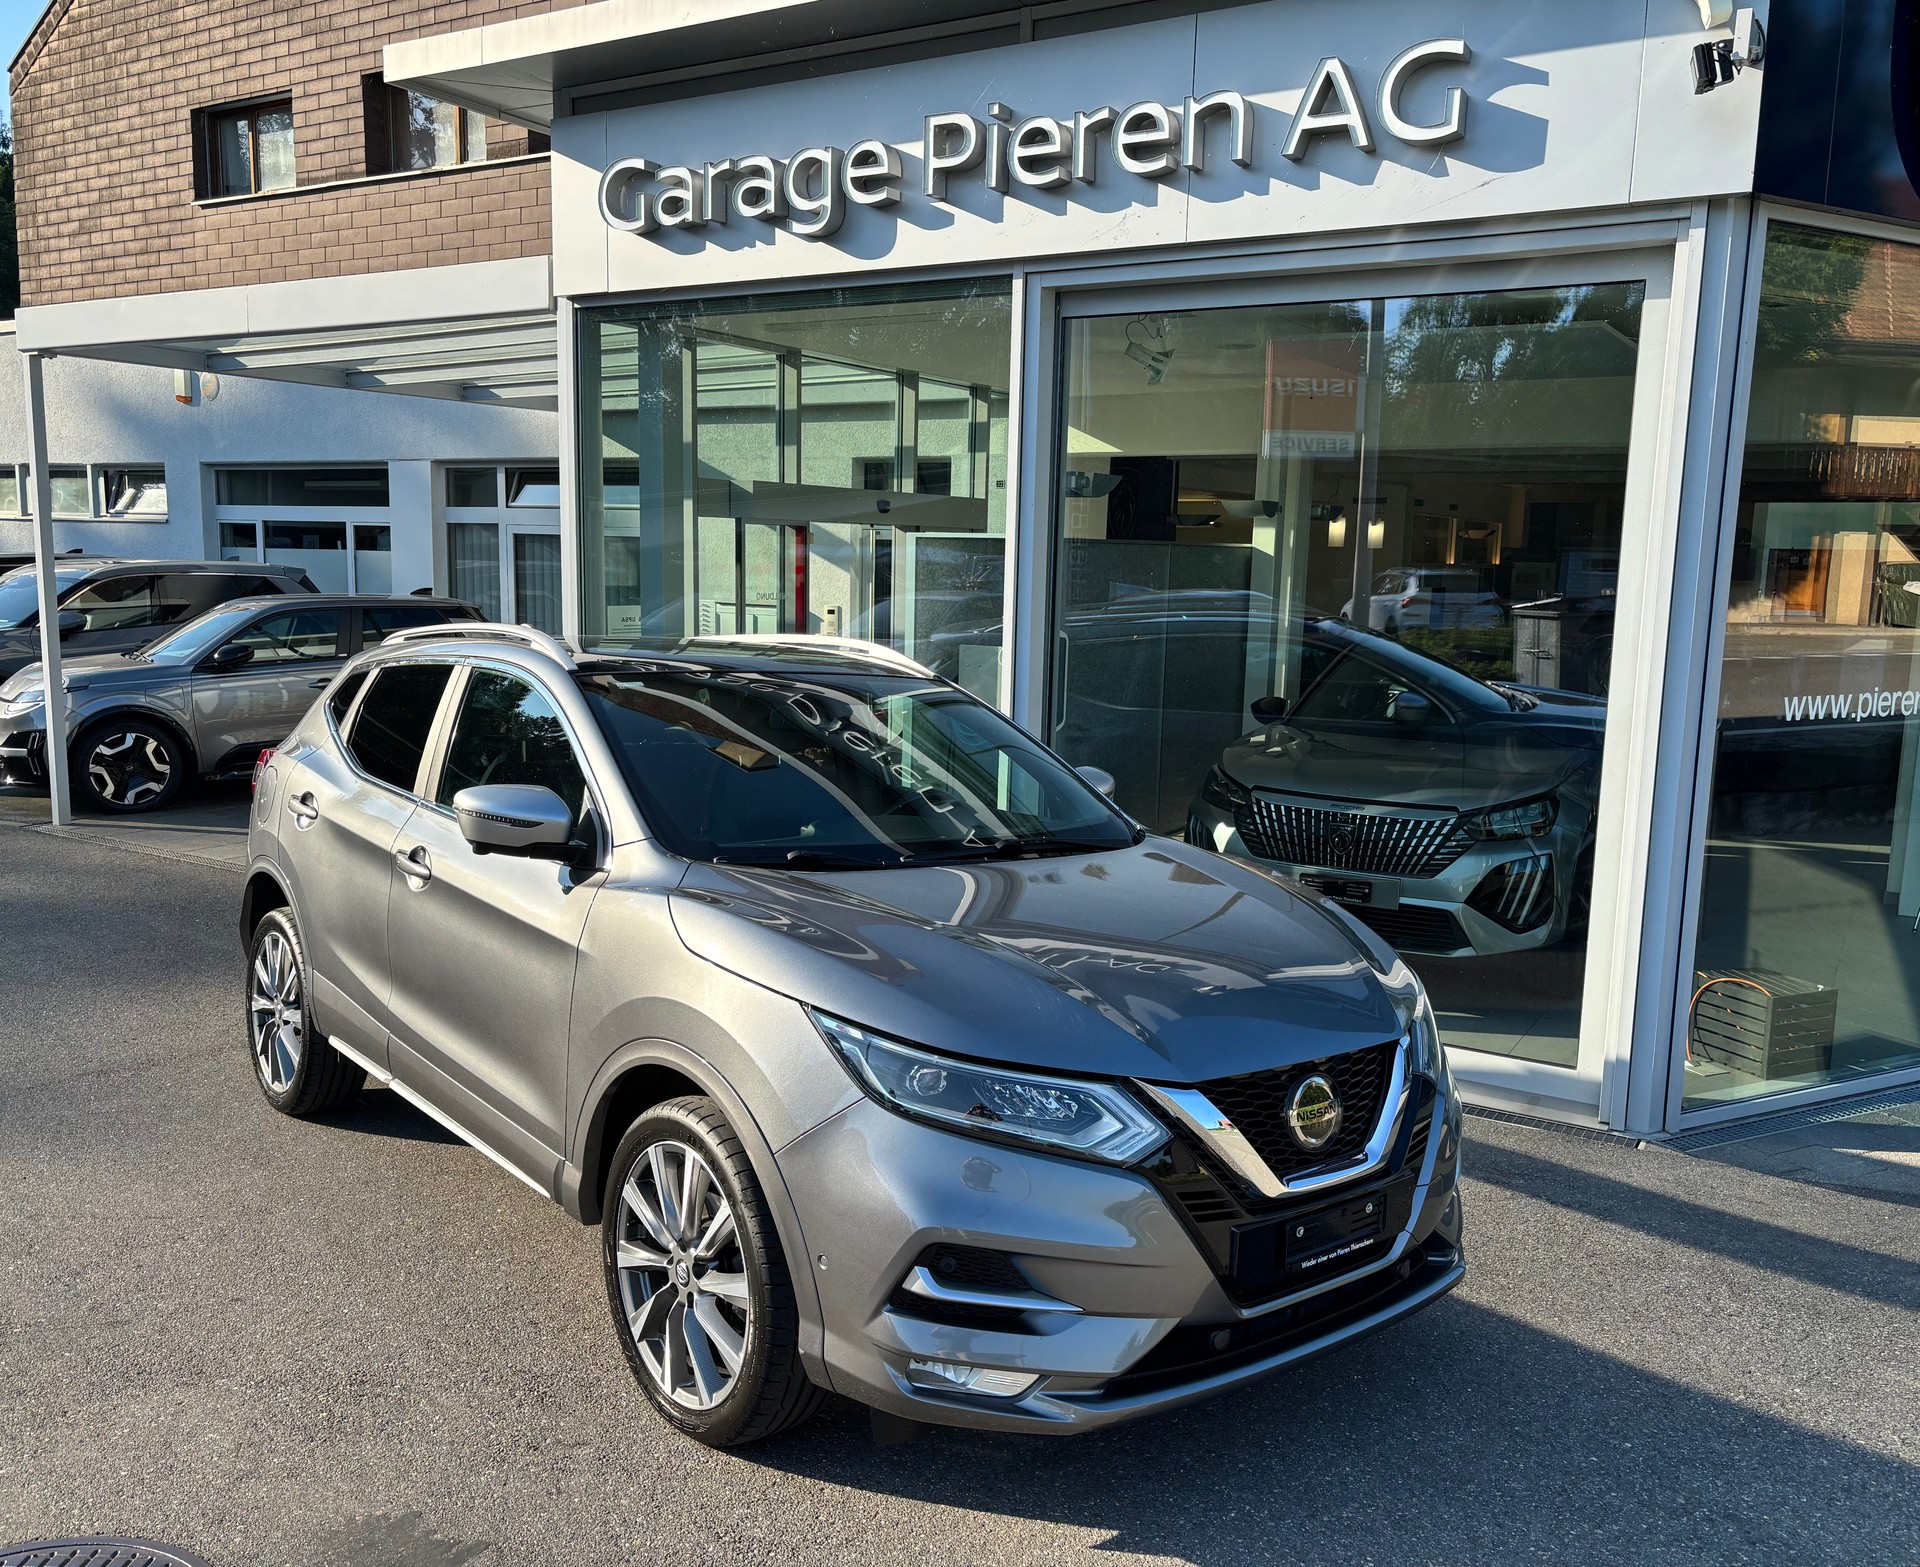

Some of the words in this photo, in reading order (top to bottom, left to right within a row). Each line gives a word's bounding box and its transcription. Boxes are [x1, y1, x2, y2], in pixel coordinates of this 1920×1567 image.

[598, 139, 901, 237] Garage
[922, 89, 1254, 200] Pieren
[1280, 37, 1473, 162] AG
[1296, 1102, 1337, 1122] NISSAN
